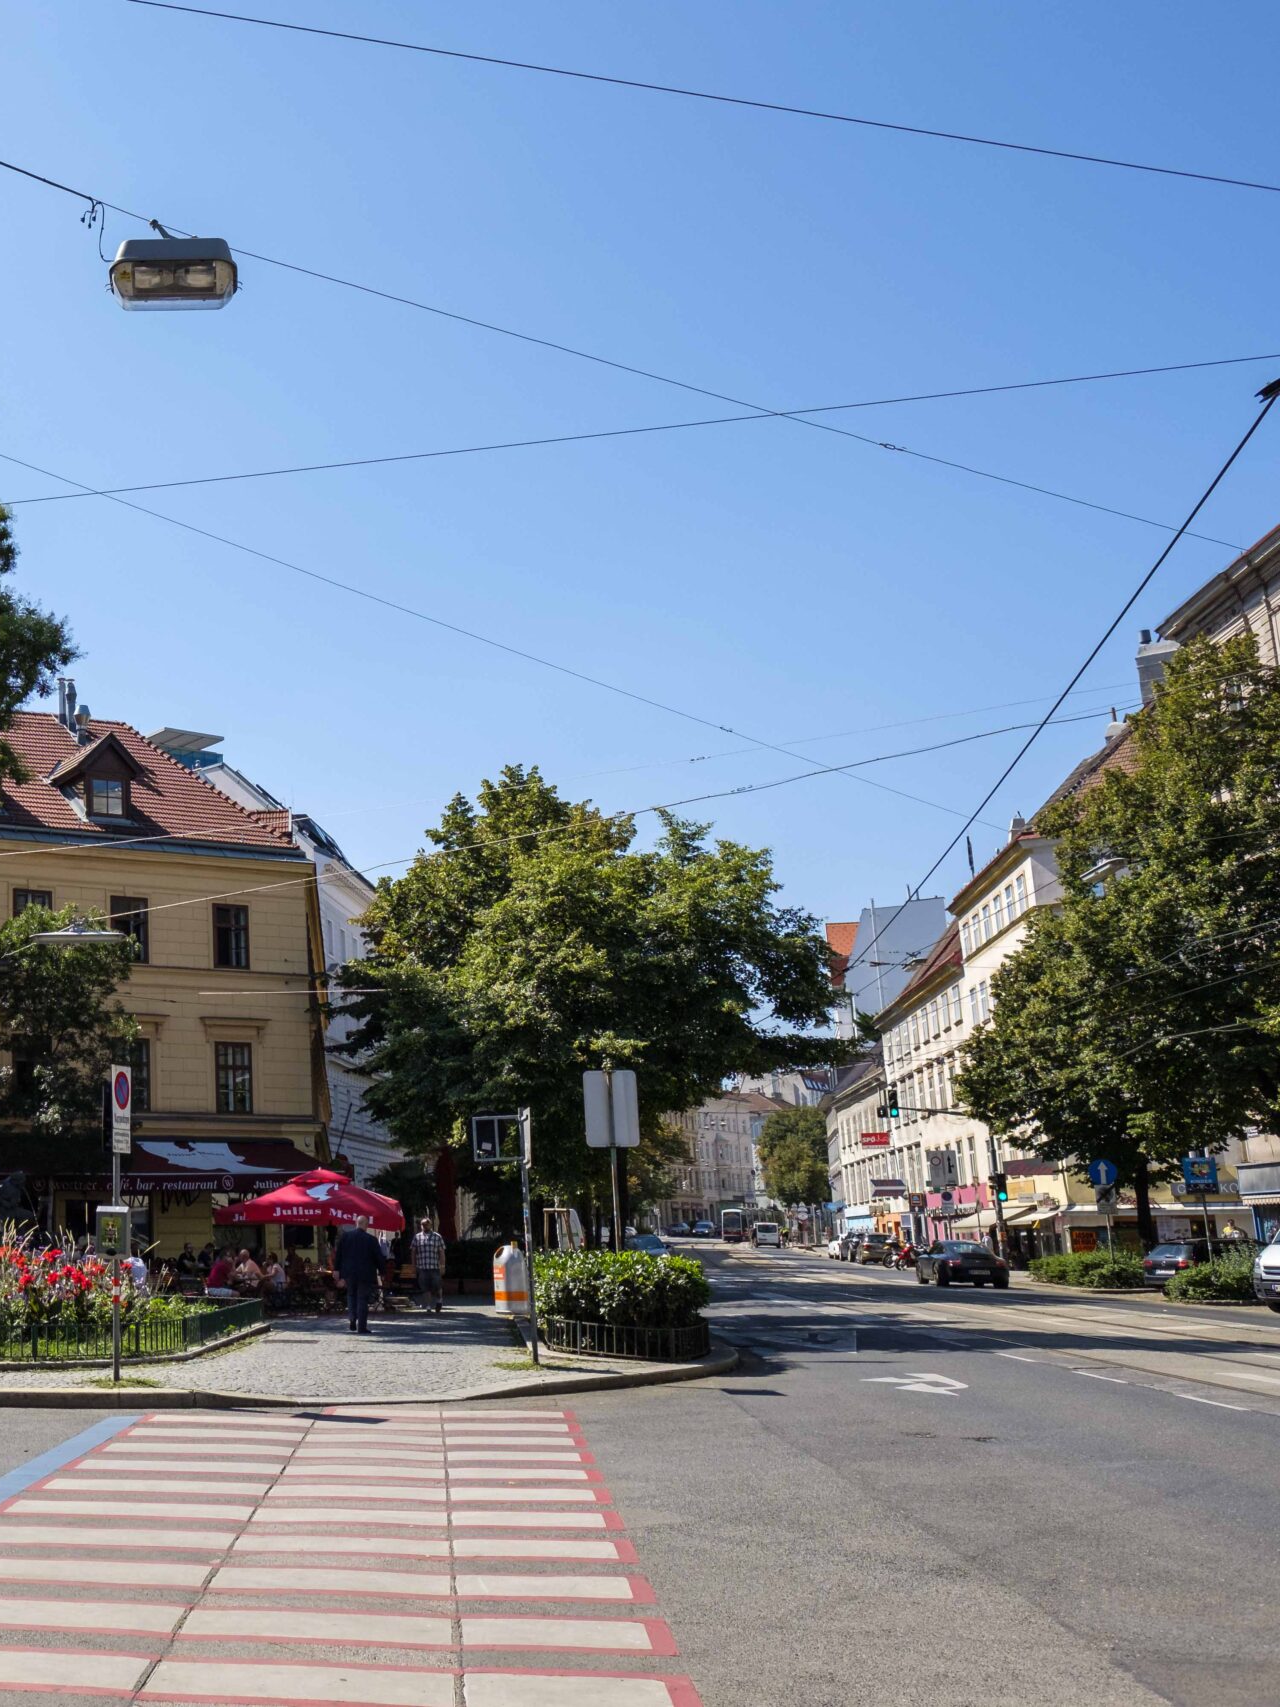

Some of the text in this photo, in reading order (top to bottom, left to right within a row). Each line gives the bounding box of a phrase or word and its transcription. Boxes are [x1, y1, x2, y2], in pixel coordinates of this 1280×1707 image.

[163, 1178, 217, 1190] restaurant
[273, 1206, 374, 1225] Julius Meil
